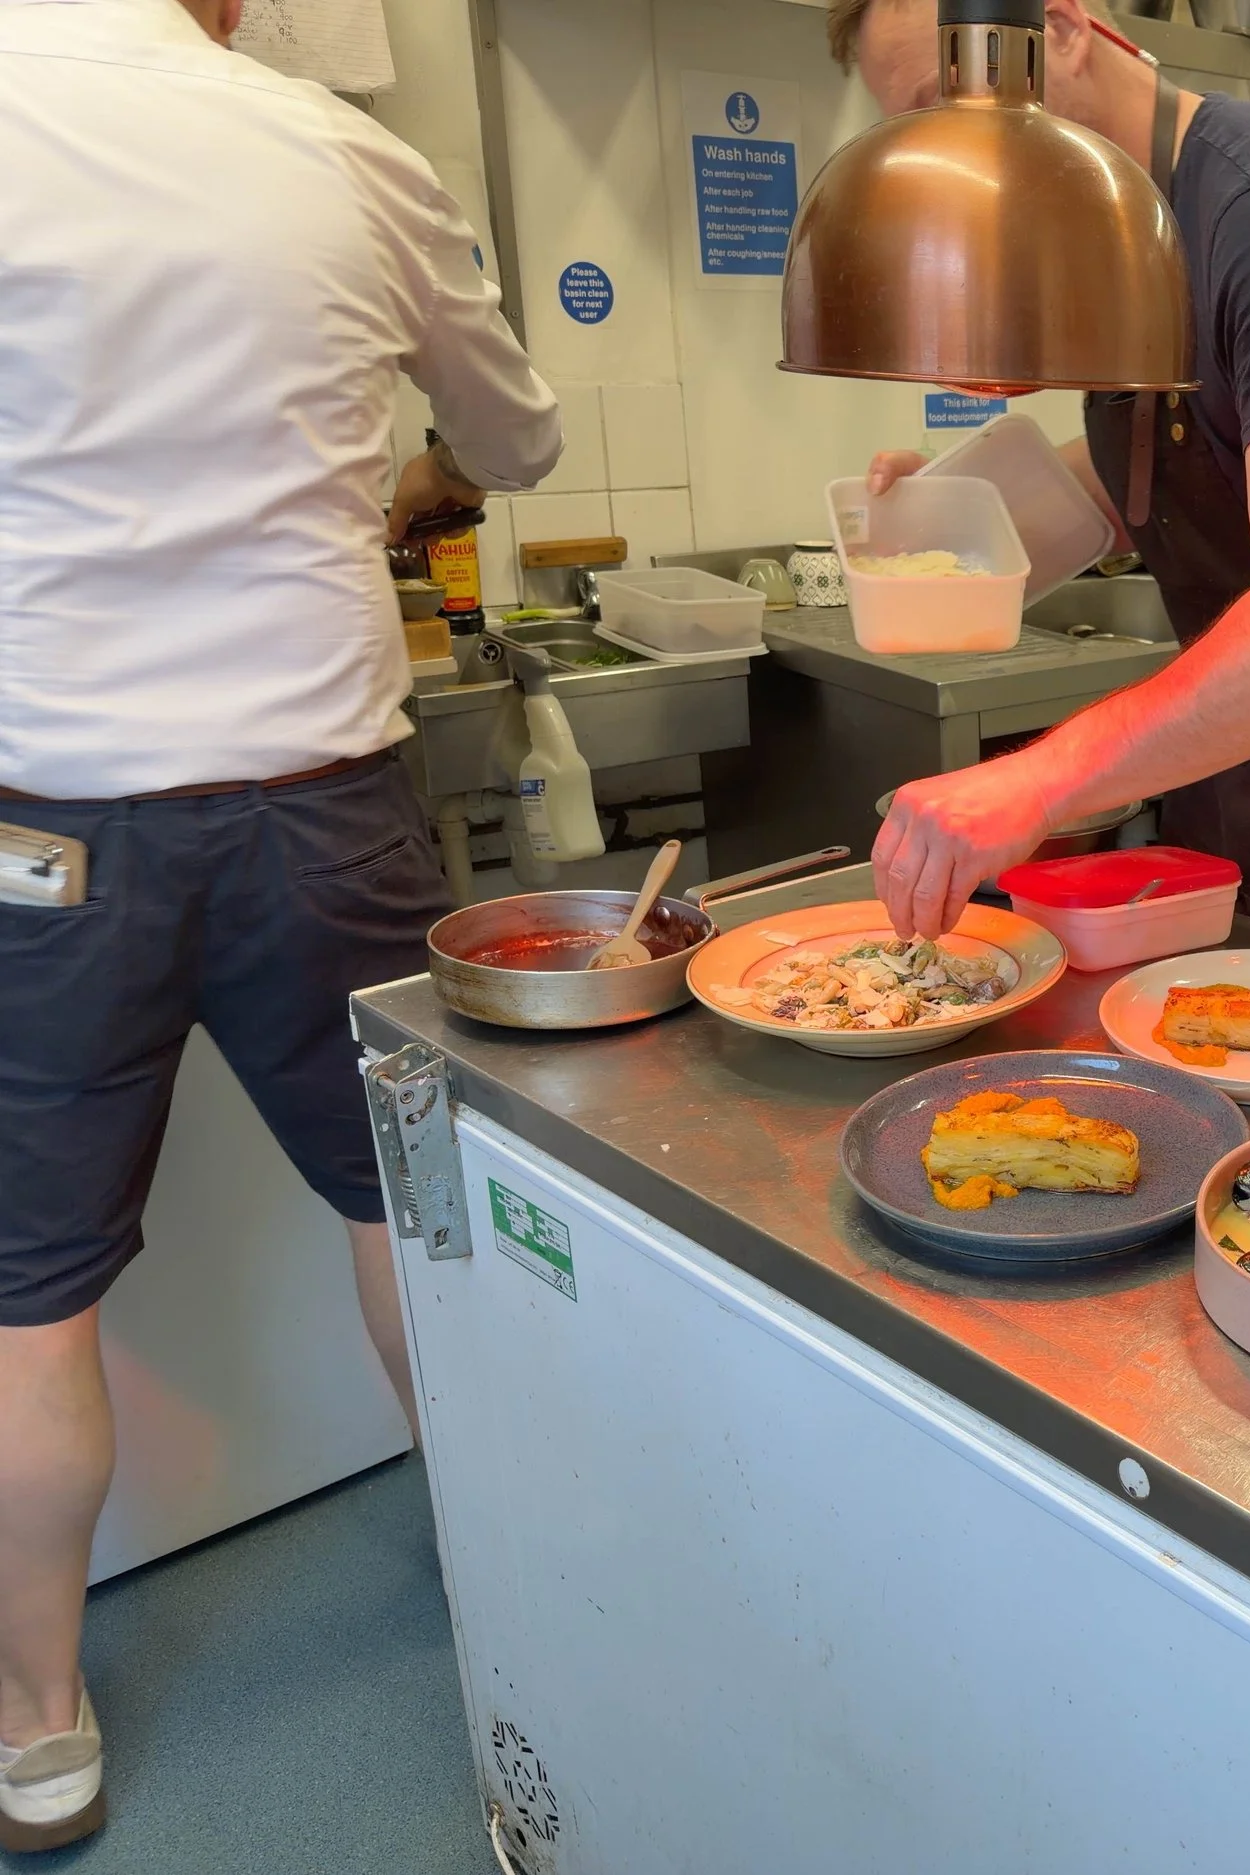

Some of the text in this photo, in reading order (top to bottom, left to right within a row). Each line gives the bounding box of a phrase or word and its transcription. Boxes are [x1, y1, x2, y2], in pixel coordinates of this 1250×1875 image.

[704, 145, 787, 165] Wash hands
[702, 168, 773, 181] On entering kitchen
[703, 186, 753, 198] After each job
[705, 205, 789, 216] After handling raw food
[706, 222, 725, 231] After
[758, 225, 789, 235] cleaning
[706, 231, 744, 241] chemicals
[708, 248, 726, 257] After
[708, 258, 724, 266] etc.
[571, 267, 598, 276] Please
[566, 279, 604, 288] leave this
[564, 289, 609, 298] basin clean
[572, 299, 603, 309] for next
[579, 311, 598, 319] user
[943, 398, 990, 408] This sink for
[928, 413, 947, 422] food
[947, 413, 988, 424] equipment
